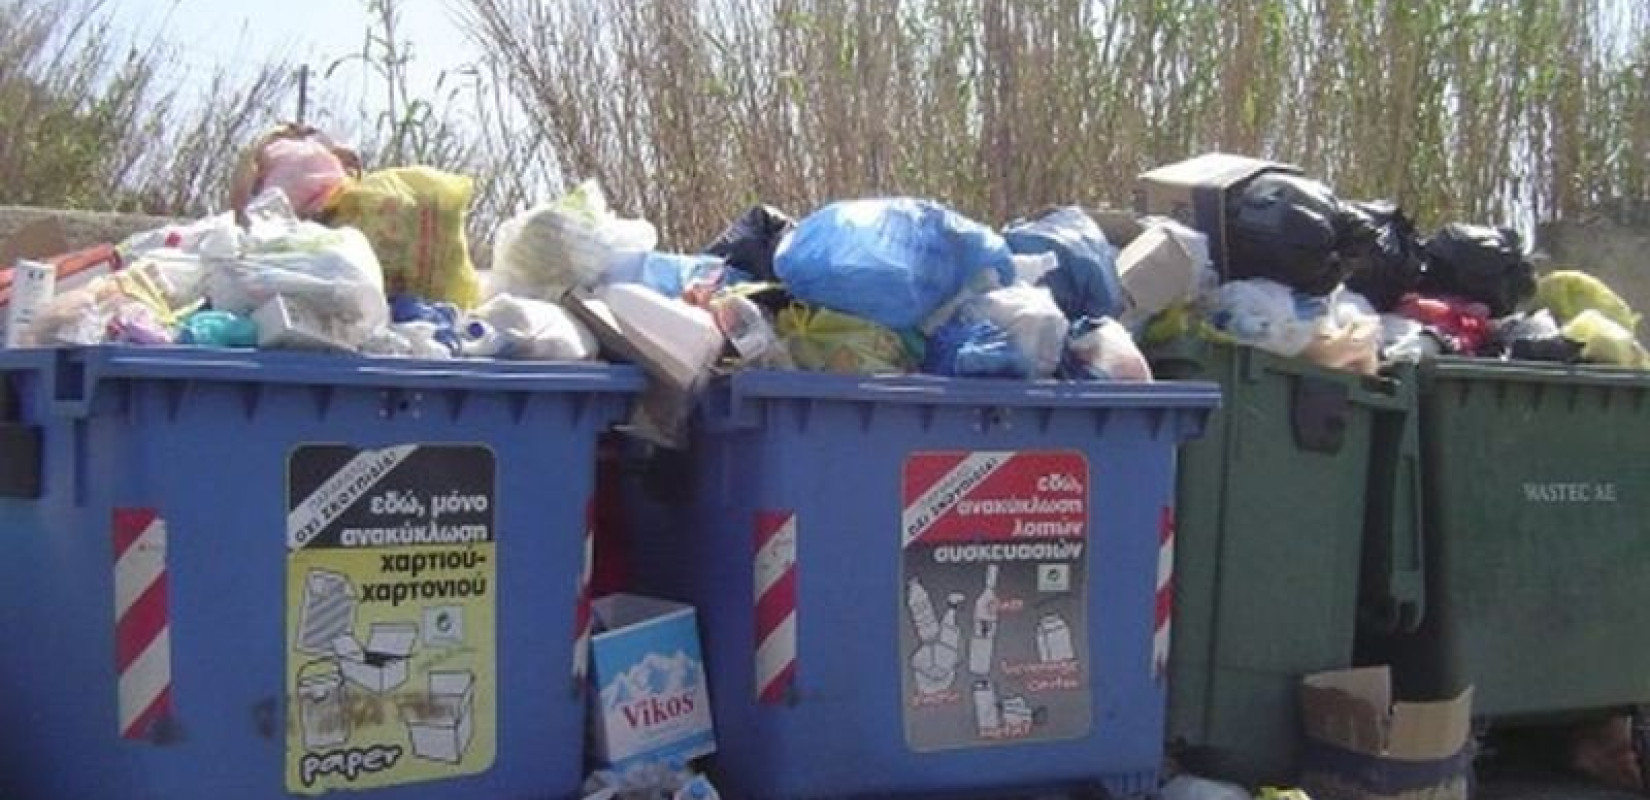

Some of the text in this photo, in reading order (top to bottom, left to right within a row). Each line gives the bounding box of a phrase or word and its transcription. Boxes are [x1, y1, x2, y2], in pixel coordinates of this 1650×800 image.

[370, 490, 488, 518] εδώ, μόνο
[1523, 481, 1591, 501] WASTEC
[340, 519, 488, 545] ανακύκλωση
[380, 543, 487, 577] χαρτιού-
[360, 573, 486, 607] χαρτονιού
[622, 693, 695, 729] Vikos
[300, 743, 403, 788] paper
